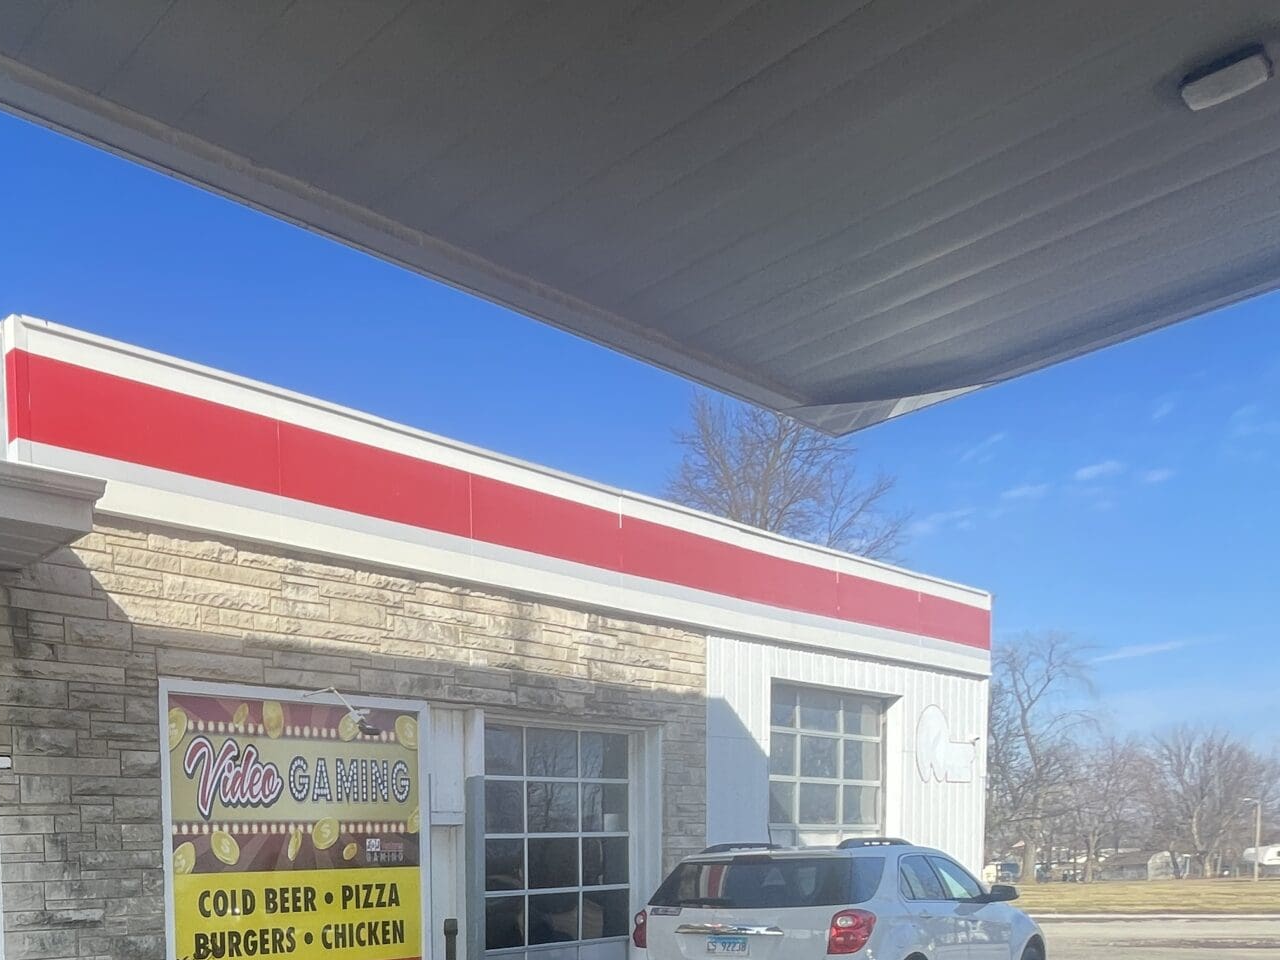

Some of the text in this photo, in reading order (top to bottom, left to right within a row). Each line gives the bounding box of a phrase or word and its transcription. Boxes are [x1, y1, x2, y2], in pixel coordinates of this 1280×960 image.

[184, 735, 410, 820] Video GAMING
[198, 883, 401, 918] COLD BEER PIZZA
[194, 919, 405, 960] BURGERS CHICKEN
